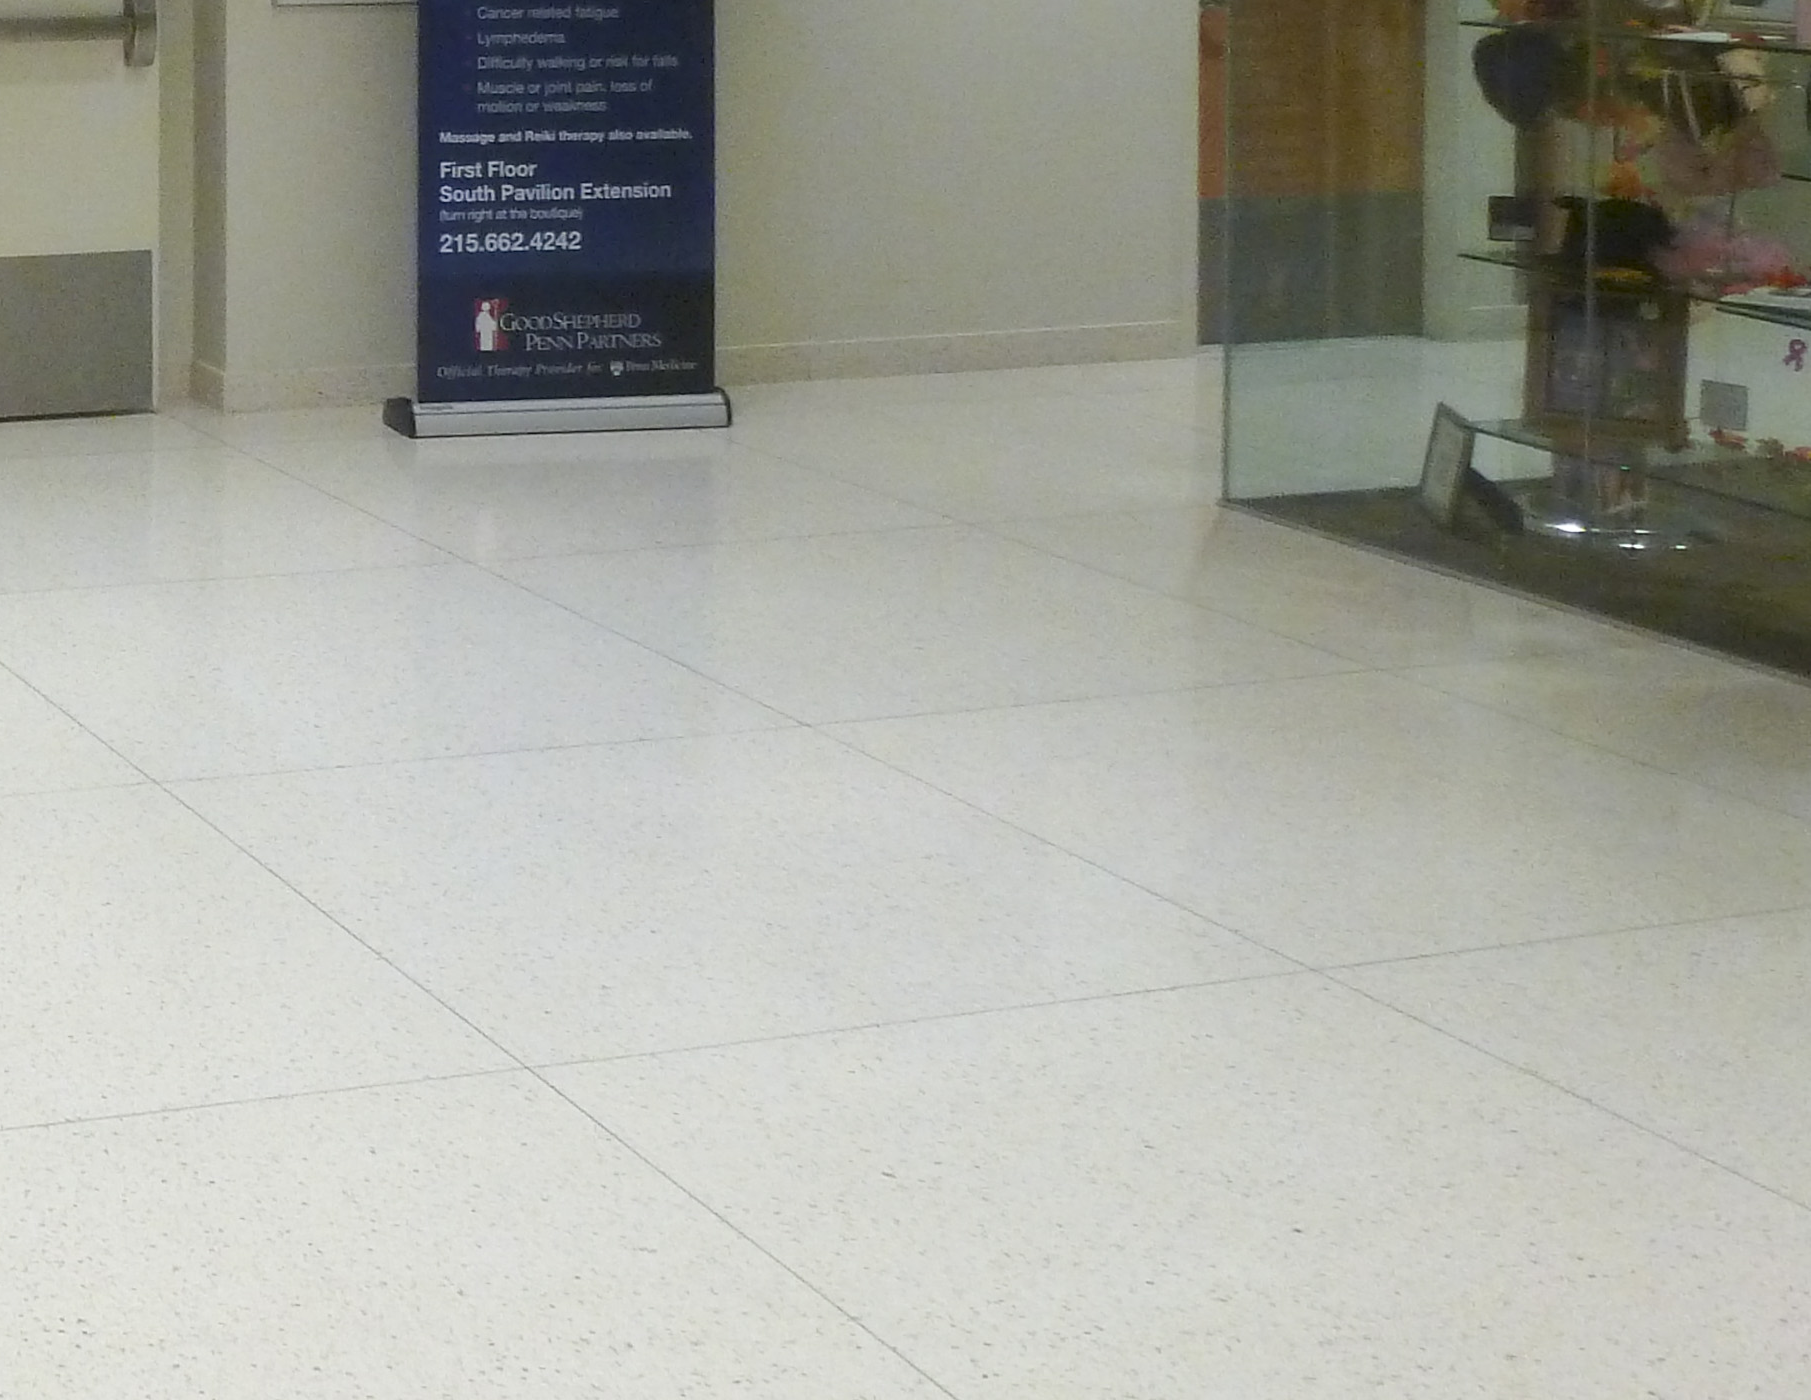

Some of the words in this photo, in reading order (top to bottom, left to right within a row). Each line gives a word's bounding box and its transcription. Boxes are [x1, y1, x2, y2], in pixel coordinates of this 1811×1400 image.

[476, 6, 525, 20] Cancer
[477, 81, 525, 96] Muscle
[527, 83, 542, 96] or
[544, 80, 573, 98] joint
[610, 79, 637, 93] loss
[640, 78, 654, 93] of
[477, 99, 524, 114] motion
[526, 101, 540, 113] or
[439, 130, 495, 146] Massage
[498, 130, 522, 143] and
[559, 129, 605, 145] therapy
[608, 129, 633, 141] also
[440, 161, 483, 179] First
[488, 160, 538, 178] Floor
[439, 185, 495, 202] South
[500, 183, 575, 202] Pavilion
[580, 181, 672, 200] Extension
[509, 207, 528, 220] the
[439, 231, 583, 253] 215.662.4242
[526, 332, 575, 351] PENN
[577, 331, 662, 350] PARTNERS
